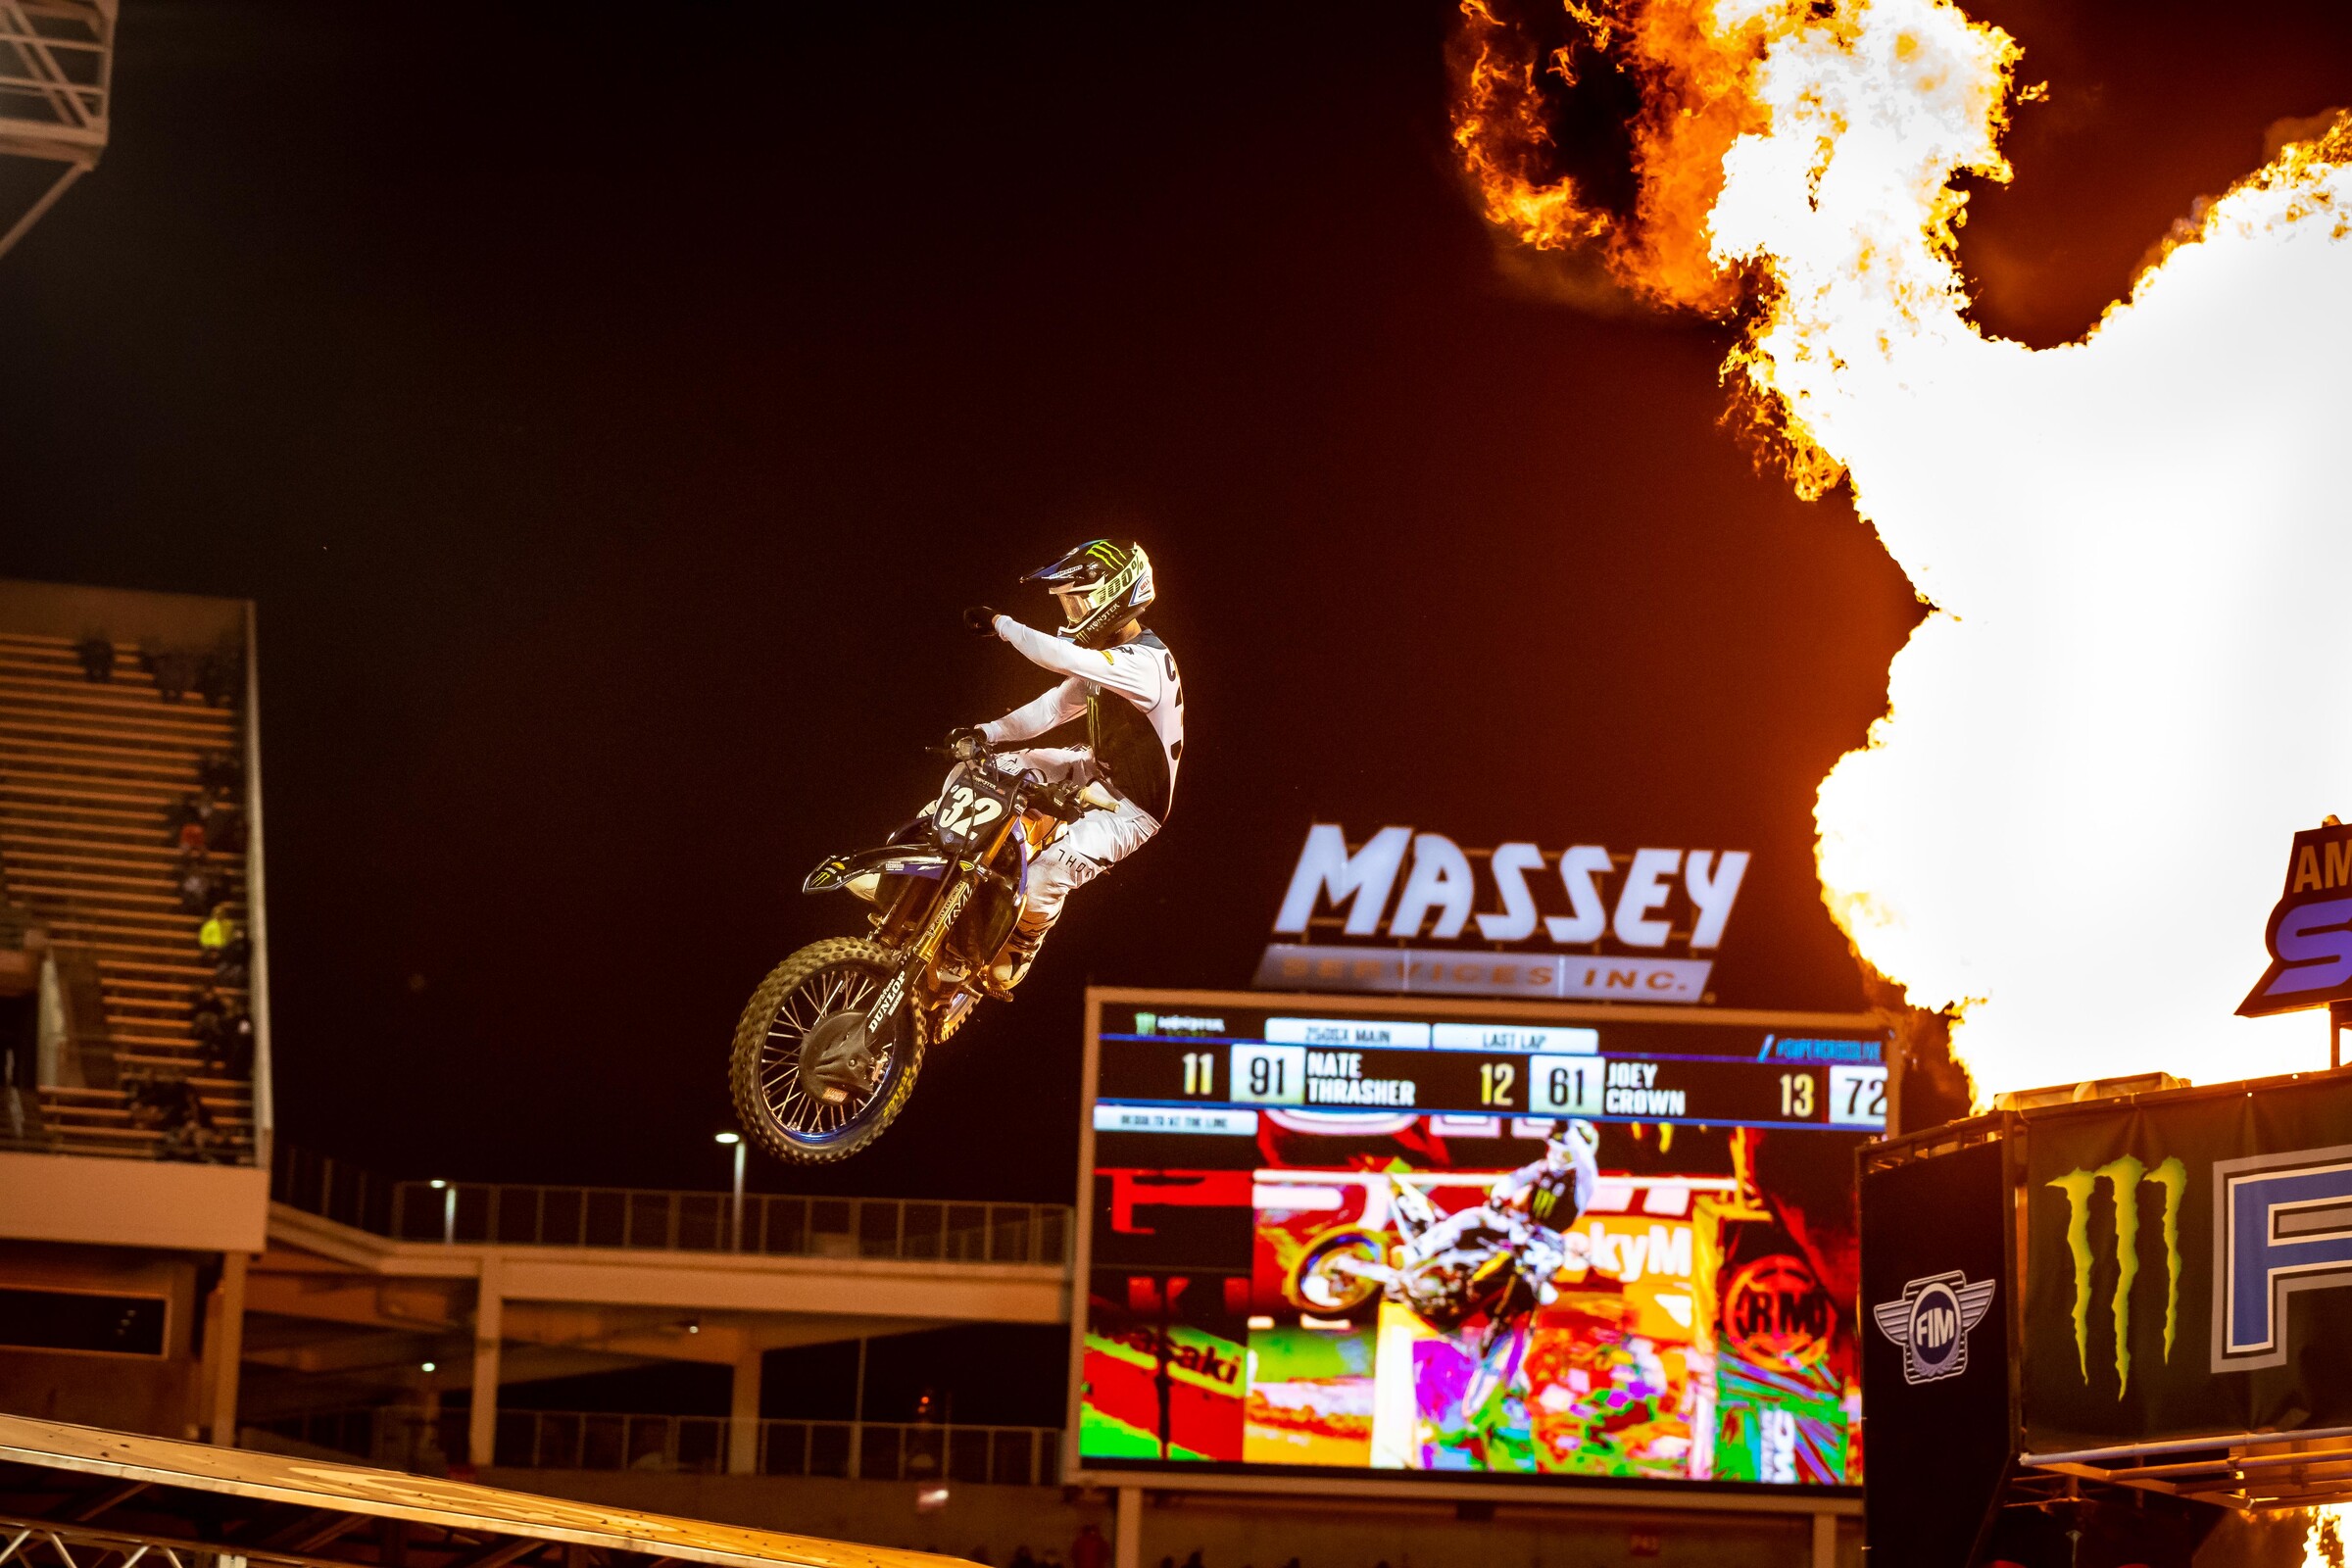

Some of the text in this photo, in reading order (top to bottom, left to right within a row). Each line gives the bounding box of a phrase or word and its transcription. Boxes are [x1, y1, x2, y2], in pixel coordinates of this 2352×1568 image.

[1097, 555, 1145, 605] 100%
[1086, 602, 1120, 632] MONSTER
[938, 787, 1003, 841] 32
[1272, 824, 1752, 950] MASSEY
[1281, 955, 1688, 993] SERVICES INC.
[868, 970, 906, 1033] DUNLOP
[1483, 1032, 1546, 1051] LAST LAP
[1183, 1052, 1214, 1096] 11
[1250, 1055, 1285, 1097] 91
[1307, 1052, 1363, 1079] NATE
[1480, 1062, 1515, 1106] 12
[1548, 1066, 1585, 1106] 61
[1606, 1061, 1658, 1089] JOEY
[1307, 1077, 1416, 1106] THRASHER
[1605, 1088, 1687, 1116] CROWN
[1780, 1073, 1815, 1118] 13
[1844, 1078, 1886, 1116] 72
[1916, 1306, 1954, 1348] FIM
